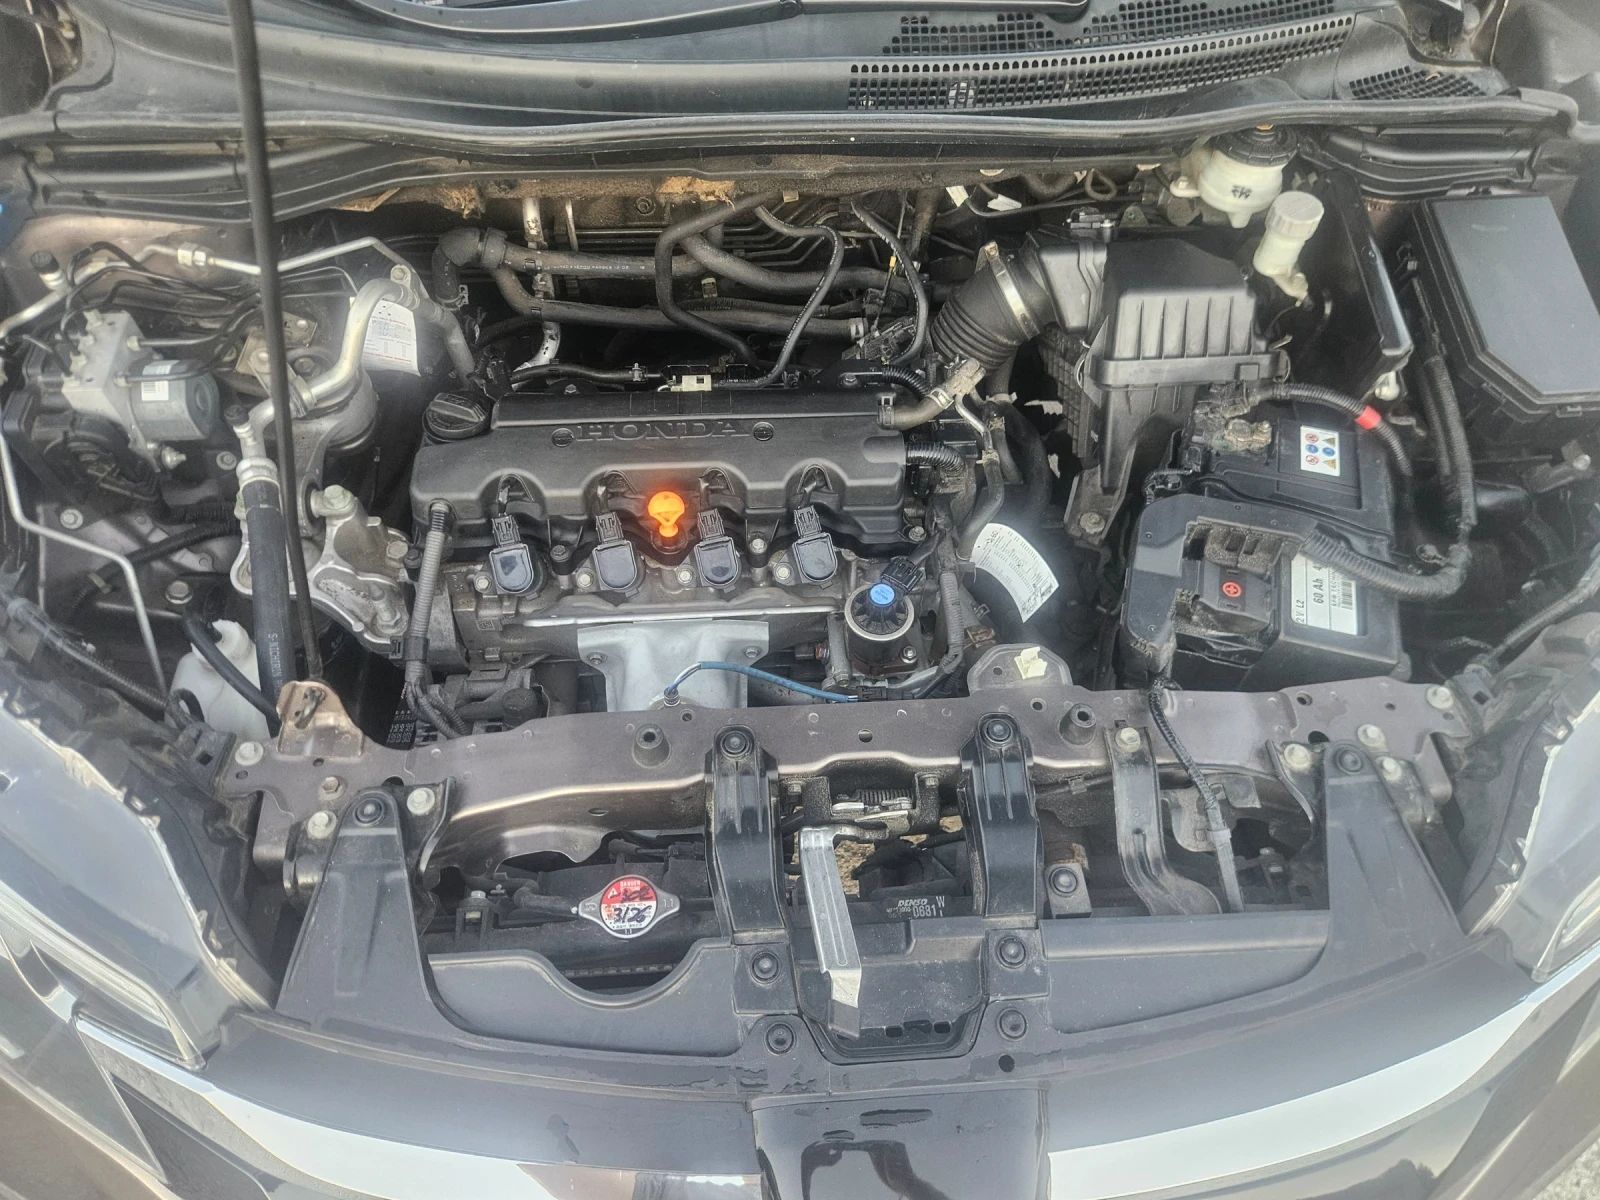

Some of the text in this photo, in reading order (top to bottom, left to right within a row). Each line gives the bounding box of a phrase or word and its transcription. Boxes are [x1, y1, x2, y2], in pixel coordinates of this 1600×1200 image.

[576, 421, 750, 441] HONDA
[1312, 578, 1325, 592] Ah
[1312, 592, 1325, 604] 60
[898, 898, 928, 907] DENSO
